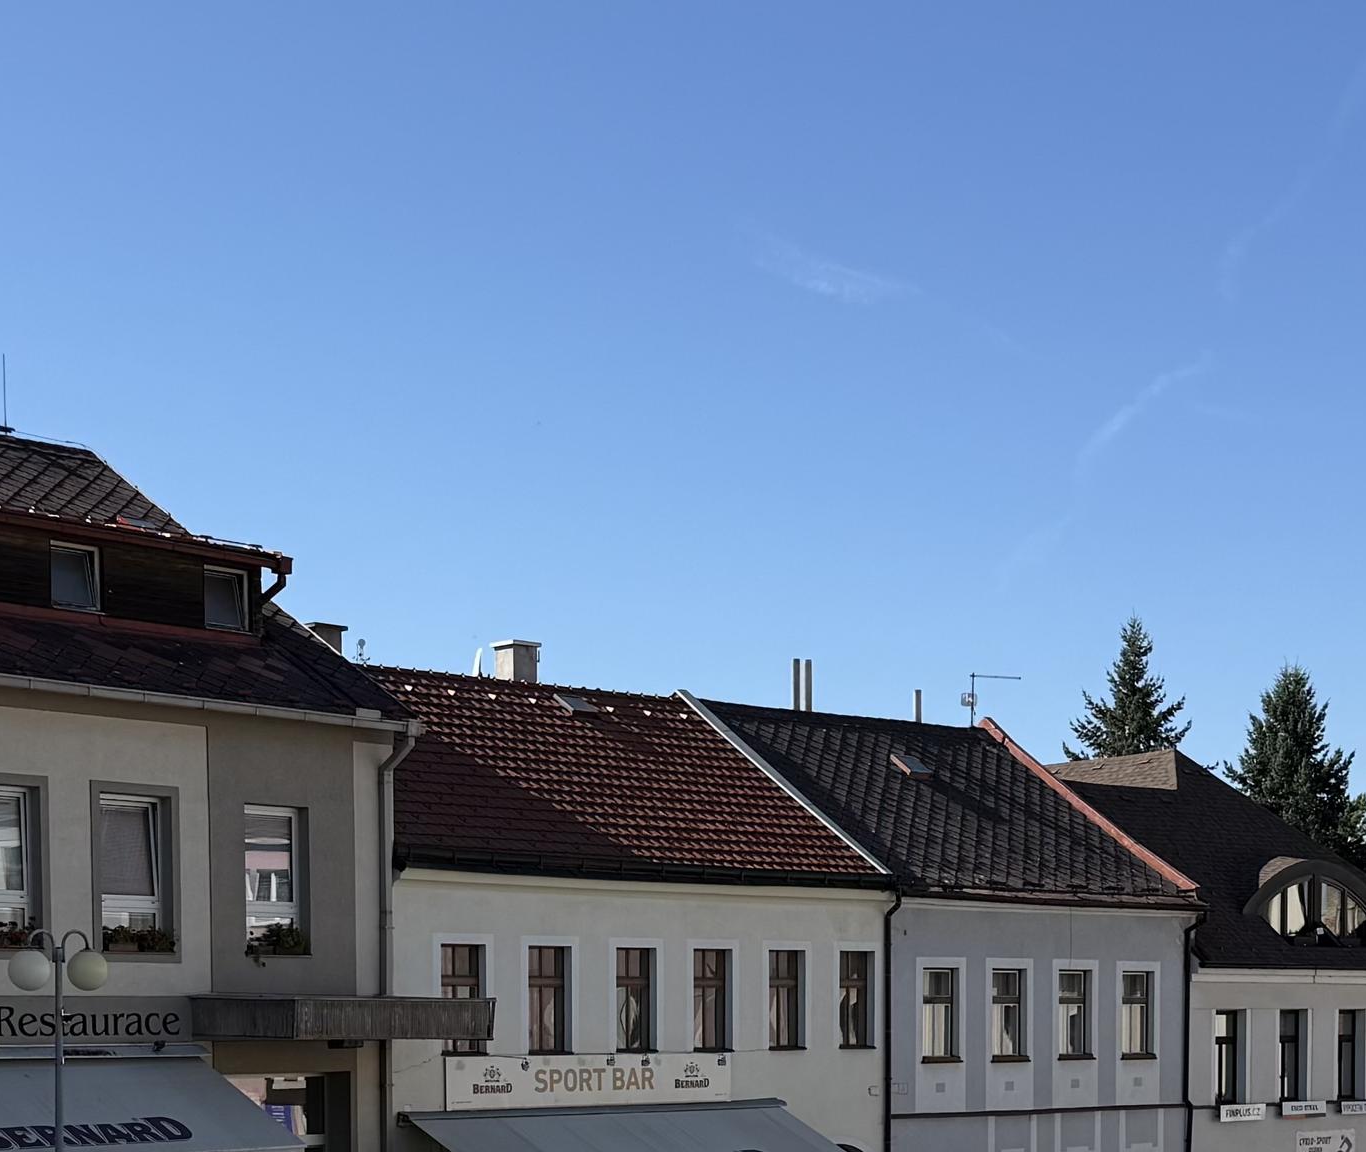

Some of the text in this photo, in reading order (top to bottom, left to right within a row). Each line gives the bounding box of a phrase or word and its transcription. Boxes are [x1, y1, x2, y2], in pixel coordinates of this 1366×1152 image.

[534, 1066, 655, 1094] SPORT BAR
[674, 1077, 710, 1090] BERNARD
[472, 1083, 513, 1095] BERNARD
